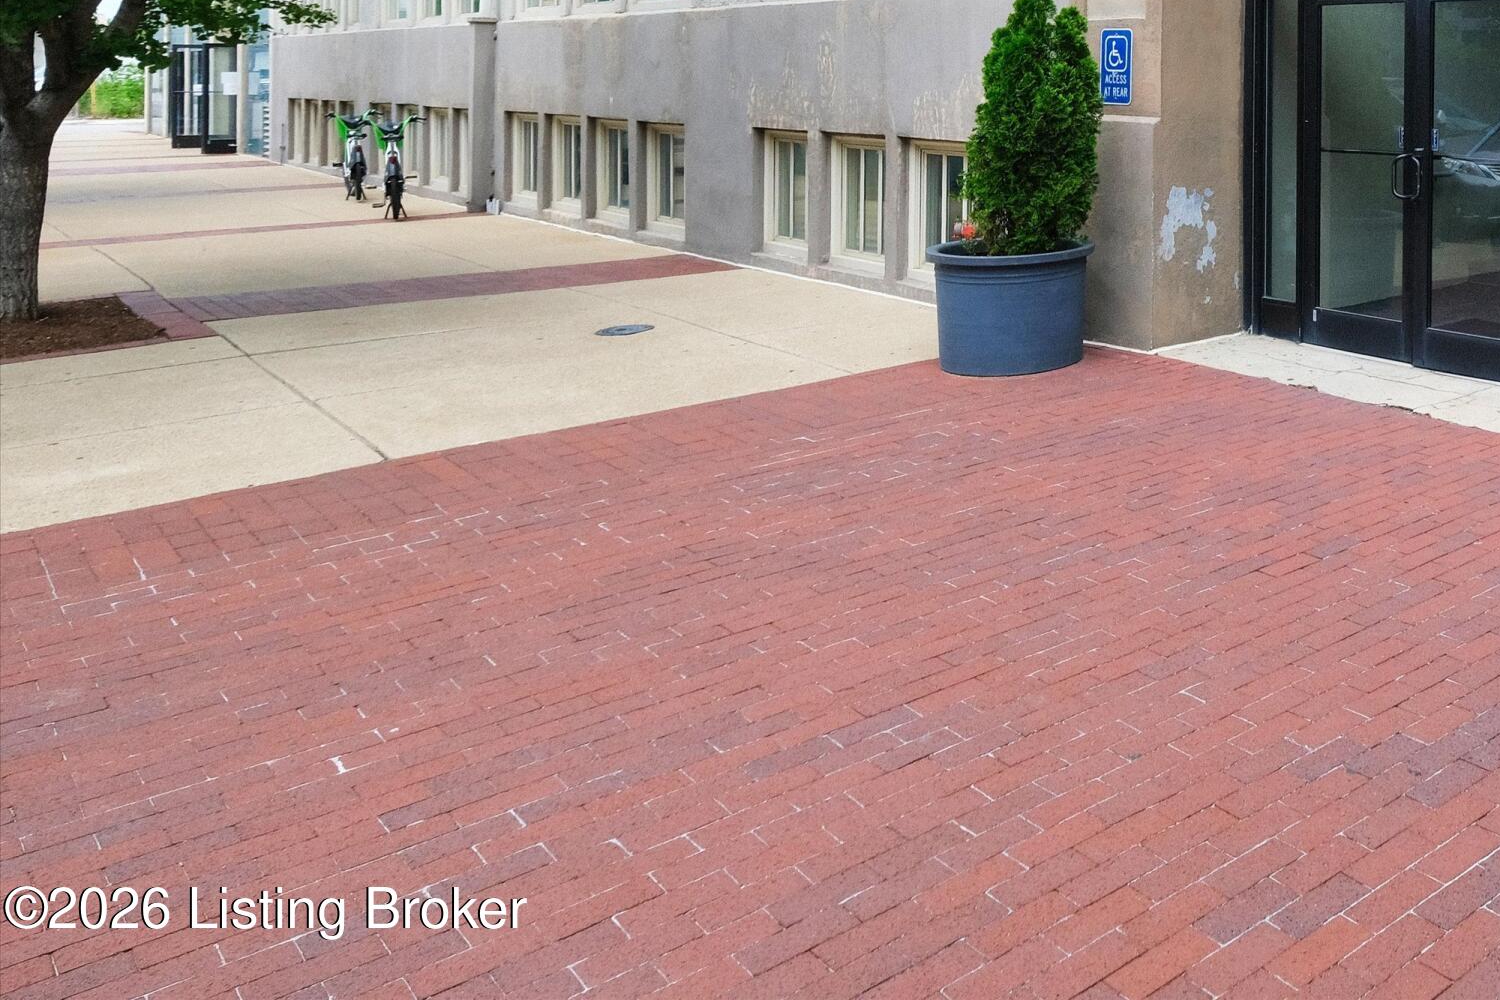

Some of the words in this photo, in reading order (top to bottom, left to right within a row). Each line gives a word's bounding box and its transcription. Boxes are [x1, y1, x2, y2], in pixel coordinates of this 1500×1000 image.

[1104, 74, 1127, 84] ACCESS
[1103, 86, 1111, 97] AT
[1112, 87, 1128, 97] REAR
